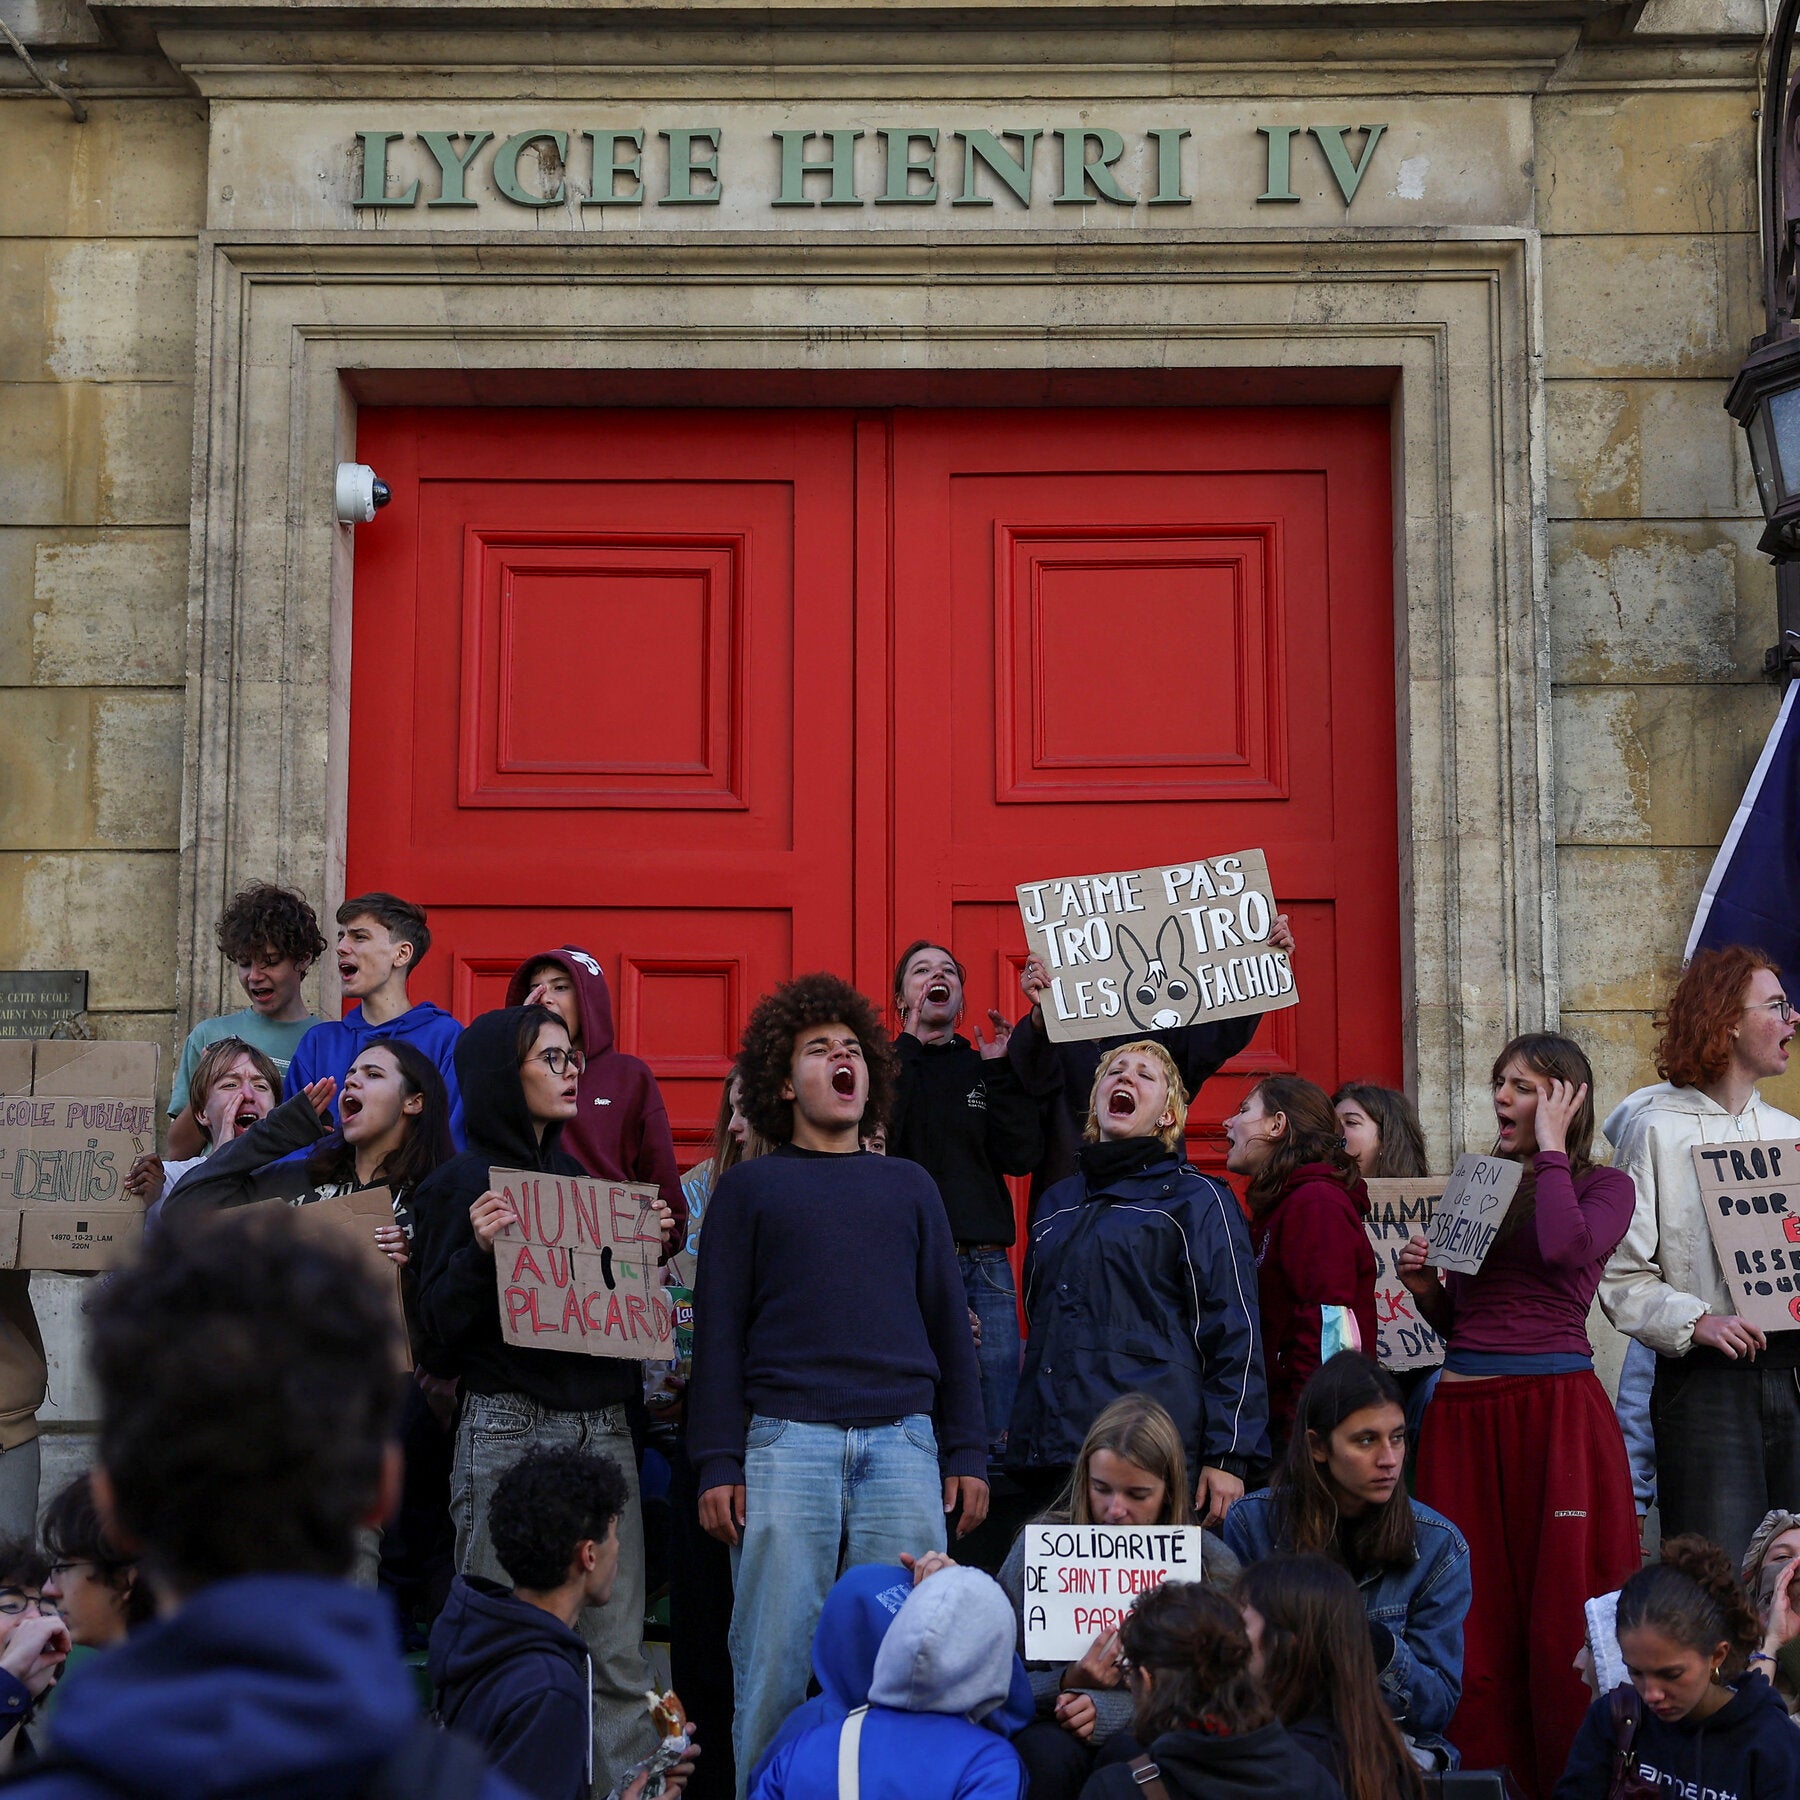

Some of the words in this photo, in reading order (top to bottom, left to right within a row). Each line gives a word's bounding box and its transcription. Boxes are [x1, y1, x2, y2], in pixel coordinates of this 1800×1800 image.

[352, 127, 723, 209] LYCEE
[771, 127, 1192, 209] HENRI
[1256, 123, 1388, 208] IV
[1161, 857, 1247, 906] PAS
[1037, 916, 1115, 970] TRO
[1180, 889, 1273, 955] TRO
[7, 992, 37, 1003] CETTE
[40, 990, 71, 1003] ÉCOLE
[1050, 976, 1122, 1022] LES
[1196, 952, 1294, 1010] FACHOS
[1455, 1165, 1466, 1177] de
[1470, 1161, 1503, 1185] RN
[1700, 1147, 1782, 1182] TROP
[1454, 1189, 1472, 1206] de
[1718, 1192, 1789, 1217] POUR
[503, 1180, 663, 1249] NUNEZ
[71, 1242, 90, 1250] 220N
[504, 1284, 673, 1343] PLACARD
[1026, 1566, 1049, 1593] DE
[1057, 1566, 1112, 1595] SAINT
[1028, 1605, 1046, 1631] A
